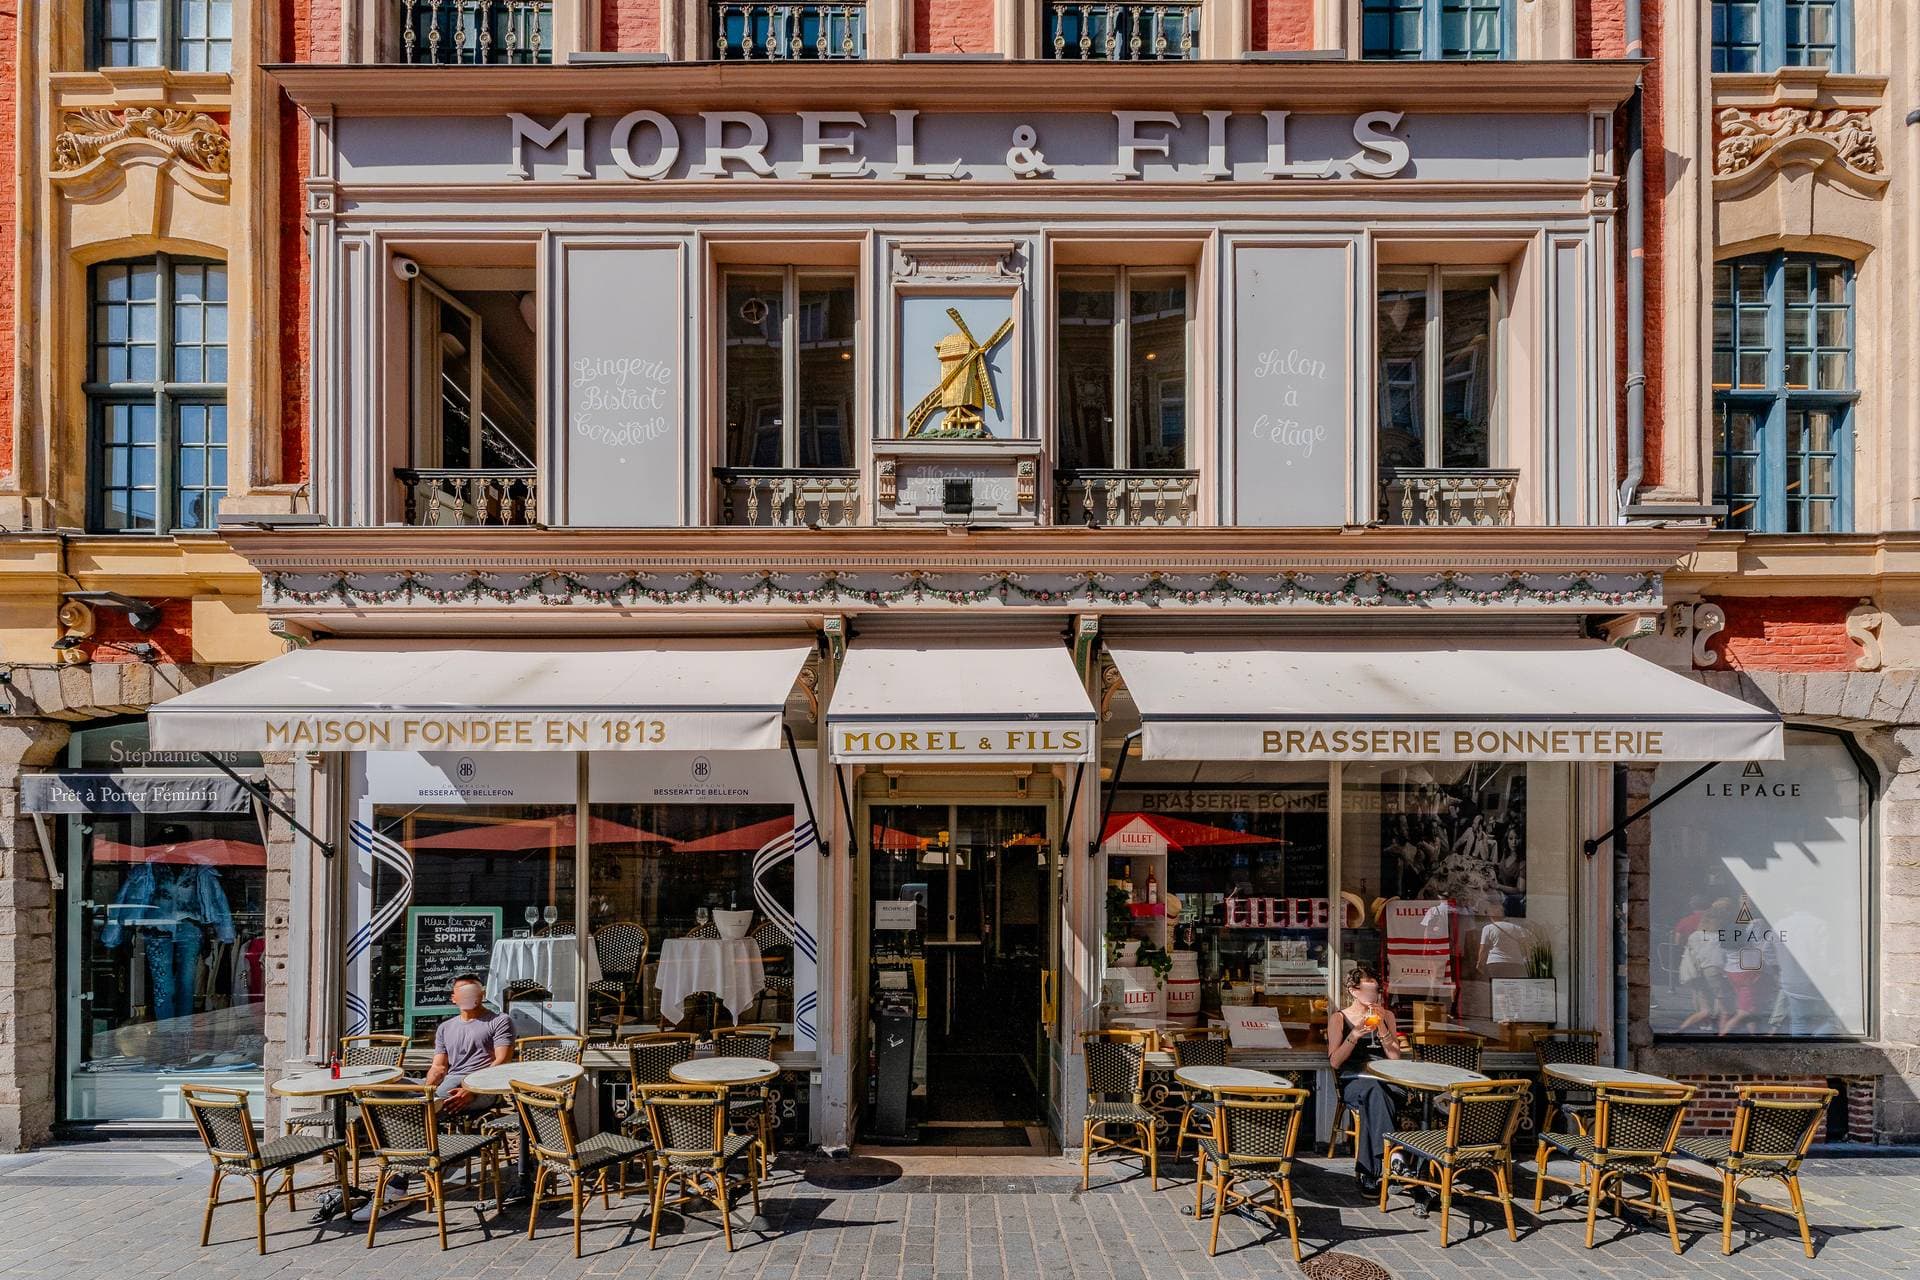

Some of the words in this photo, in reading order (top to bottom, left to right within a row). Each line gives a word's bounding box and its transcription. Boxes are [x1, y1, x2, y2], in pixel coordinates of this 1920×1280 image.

[505, 110, 962, 180] MOREL
[1006, 124, 1054, 177] &
[1111, 110, 1410, 180] FILS
[1254, 348, 1327, 379] Salon
[573, 357, 671, 388] Lingerie
[581, 386, 666, 411] Bistrot
[265, 719, 391, 745] MAISON
[403, 719, 533, 745] FONDEE
[546, 719, 589, 745] EN
[600, 719, 667, 744] 1813
[843, 731, 966, 752] MOREL
[978, 737, 992, 750] &
[1006, 731, 1082, 750] FILS
[1262, 729, 1442, 755] BRASSERIE
[1453, 730, 1664, 755] BONNETERIE
[109, 739, 201, 769] Stéphanie
[51, 787, 82, 802] Prêt
[86, 788, 96, 802] à
[101, 787, 147, 802] Porter
[153, 785, 218, 802] Féminin
[418, 789, 458, 797] BESSERAT
[460, 789, 471, 797] DE
[473, 789, 514, 797] BELLEFON
[653, 788, 694, 796] BESSERAT
[695, 788, 706, 796] DE
[708, 788, 749, 796] BELLEFON
[1706, 783, 1801, 798] LEPAGE
[1143, 793, 1250, 810] BRASSERIE
[1257, 793, 1381, 810] BONNEERIE
[1122, 834, 1153, 844] LILLET
[1396, 908, 1428, 916] LILLE
[434, 933, 476, 942] SPRITZ
[1703, 929, 1788, 943] LEPAGE
[1401, 967, 1431, 975] LILLET
[1124, 992, 1156, 1004] ILLET
[1168, 992, 1195, 1001] ILLET
